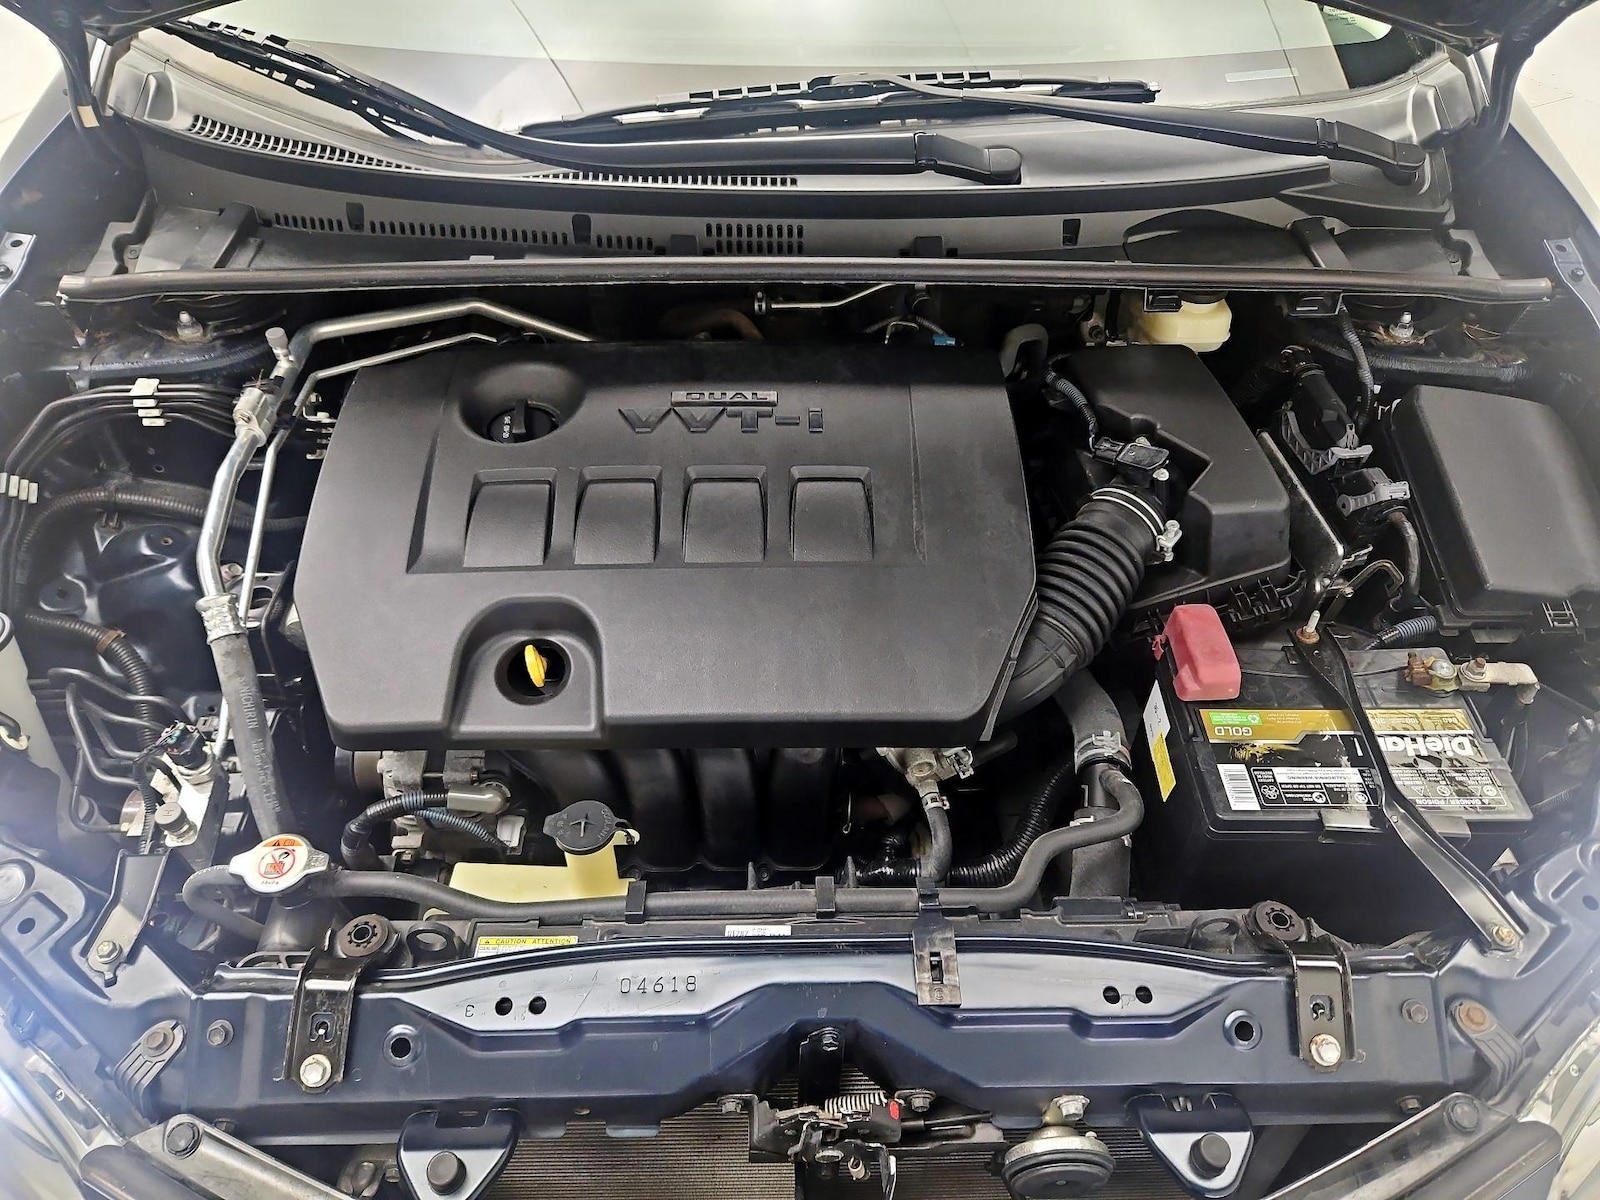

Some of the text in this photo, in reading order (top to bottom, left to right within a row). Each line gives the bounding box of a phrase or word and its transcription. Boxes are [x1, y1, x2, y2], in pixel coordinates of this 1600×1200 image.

[686, 392, 768, 401] DUAL
[1214, 726, 1253, 736] GOLD
[620, 975, 697, 994] 04618
